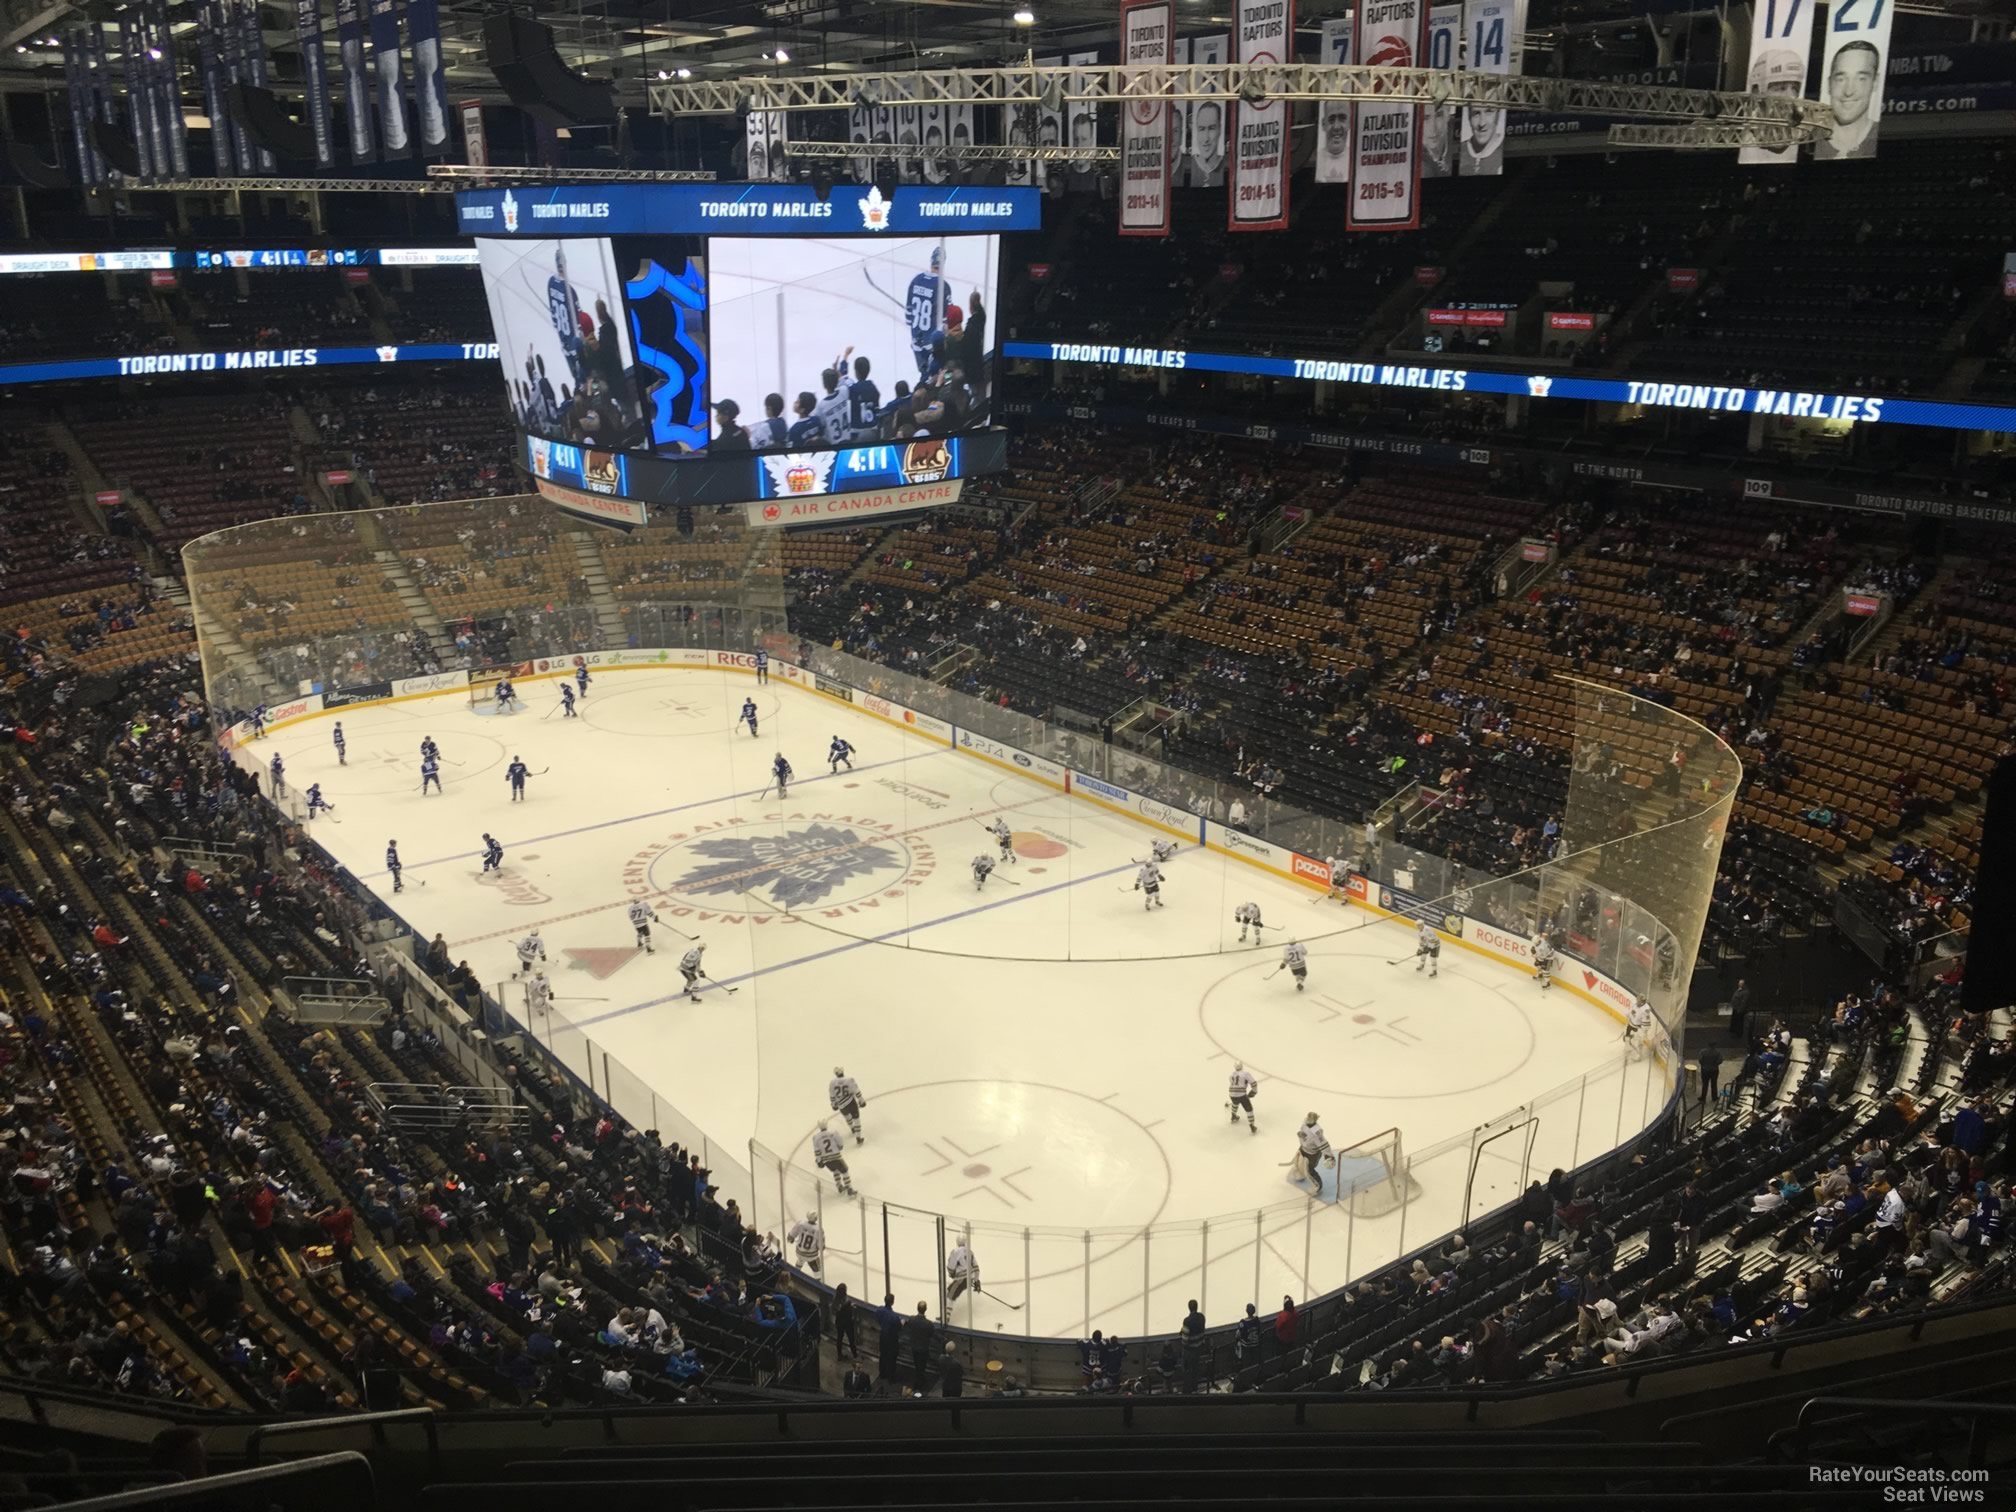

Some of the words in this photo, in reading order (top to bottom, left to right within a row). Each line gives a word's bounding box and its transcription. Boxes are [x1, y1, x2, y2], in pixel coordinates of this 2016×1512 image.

[1244, 3, 1283, 23] TORONTO
[1366, 1, 1415, 24] RAPTORS
[1131, 25, 1165, 42] TORONTO
[1244, 20, 1283, 41] RAPTORS
[1130, 42, 1164, 59] RAPTORS
[1474, 18, 1504, 67] 14
[1889, 57, 1920, 76] NBA
[1241, 120, 1279, 139] ATLANTIC
[1363, 112, 1409, 131] ATLANTIC
[1128, 135, 1162, 151] ATLANTIC
[1241, 138, 1279, 157] DIVISION
[1361, 131, 1408, 151] DIVISION
[1127, 152, 1162, 168] DIVISION
[1240, 183, 1276, 201] 2014-15
[1360, 181, 1404, 200] 2015-16
[532, 203, 567, 218] TORONTO
[569, 203, 610, 218] MARLIES
[700, 202, 767, 217] TORONTO
[772, 202, 832, 217] MARLIES
[919, 202, 969, 217] TORONTO
[971, 202, 1013, 217] MARLIES
[1127, 194, 1160, 209] 2013-14
[260, 250, 290, 266] 4:11
[911, 296, 933, 332] 38
[118, 352, 216, 376] TORONTO
[224, 349, 318, 370] MARLIES
[1051, 343, 1121, 364] TORONTO
[1124, 347, 1186, 369] MARLIES
[1294, 358, 1374, 384] TORONTO
[1380, 364, 1468, 391] MARLIES
[1003, 404, 1032, 414] LEAFS
[1626, 381, 1746, 412] TORONTO
[1753, 389, 1885, 423] MARLIES
[1310, 433, 1350, 447] TORONTO
[1354, 439, 1385, 451] MAPLE
[1390, 443, 1422, 455] LEAFS
[848, 447, 887, 472] 4:11
[1588, 465, 1605, 477] THE
[1608, 466, 1643, 480] NORTH
[1747, 482, 1769, 494] 109
[559, 490, 589, 506] CANADA
[592, 498, 633, 516] CENTRE
[791, 503, 819, 516] AIR
[827, 494, 893, 513] CANADA
[899, 487, 951, 504] CENTRE
[1855, 493, 1901, 509] TORONTO
[1904, 499, 1953, 515] RAPTORS
[551, 659, 565, 669] LG
[586, 654, 600, 665] LG
[717, 652, 758, 668] RICO
[274, 701, 307, 721] Castrol
[975, 740, 1005, 759] PS4
[1161, 806, 1190, 828] Royal
[694, 817, 748, 833] AIR
[763, 813, 894, 832] CANADA
[903, 834, 937, 887] CENTRE
[622, 843, 668, 895] CENTRE
[1295, 859, 1329, 881] pizza
[654, 900, 802, 925] CANADA
[821, 898, 881, 918] AIR
[524, 940, 538, 954] 34
[1476, 927, 1528, 957] ROGERS
[833, 1084, 850, 1099] 26
[823, 1138, 833, 1153] 2
[800, 1234, 814, 1250] 18
